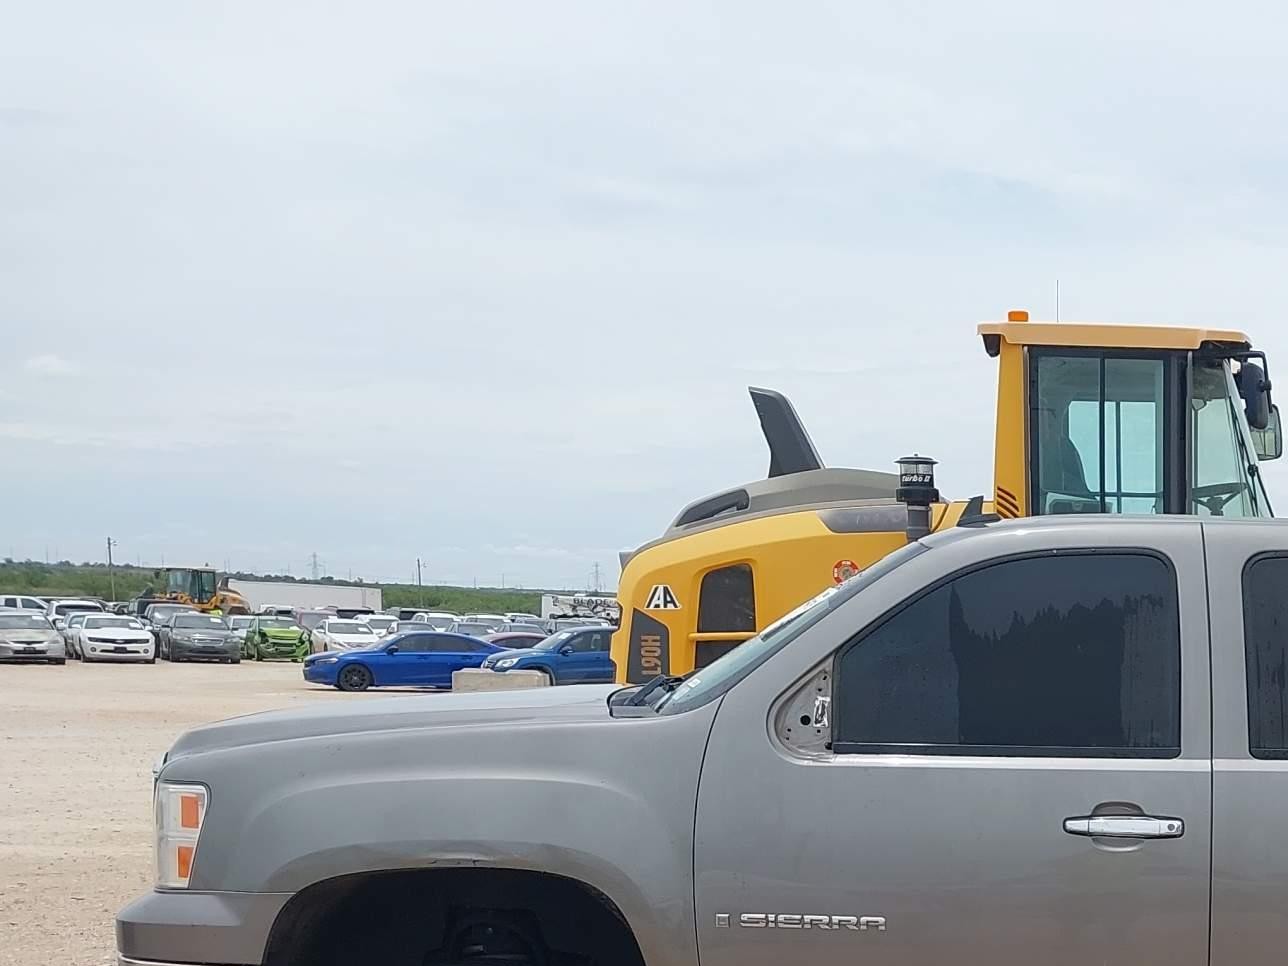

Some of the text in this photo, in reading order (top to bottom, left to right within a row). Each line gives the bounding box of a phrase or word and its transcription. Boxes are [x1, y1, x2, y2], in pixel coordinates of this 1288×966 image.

[901, 474, 923, 482] turbo
[640, 635, 662, 676] L90H
[740, 912, 888, 931] SIERRA
